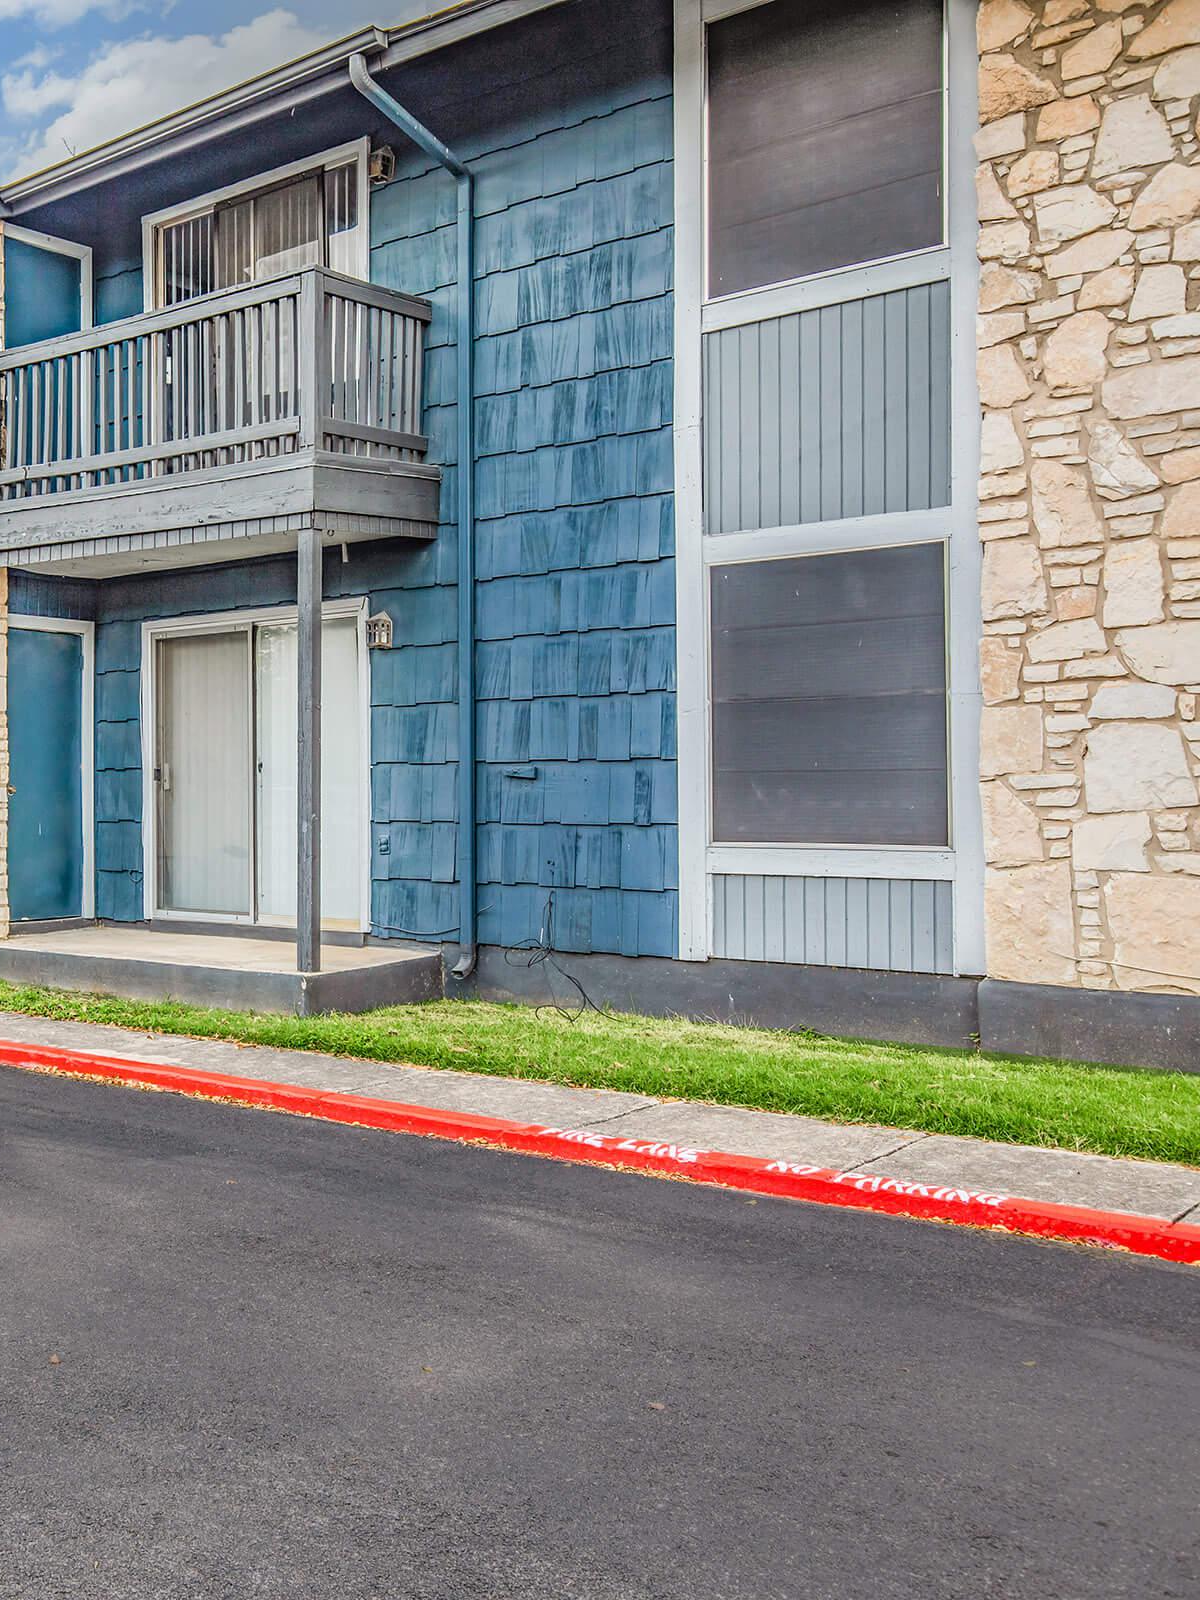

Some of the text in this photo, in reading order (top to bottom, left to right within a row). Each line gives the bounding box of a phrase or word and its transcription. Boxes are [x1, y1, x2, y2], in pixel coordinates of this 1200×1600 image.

[539, 1127, 1008, 1207] FIRE LANE NO PARKING
